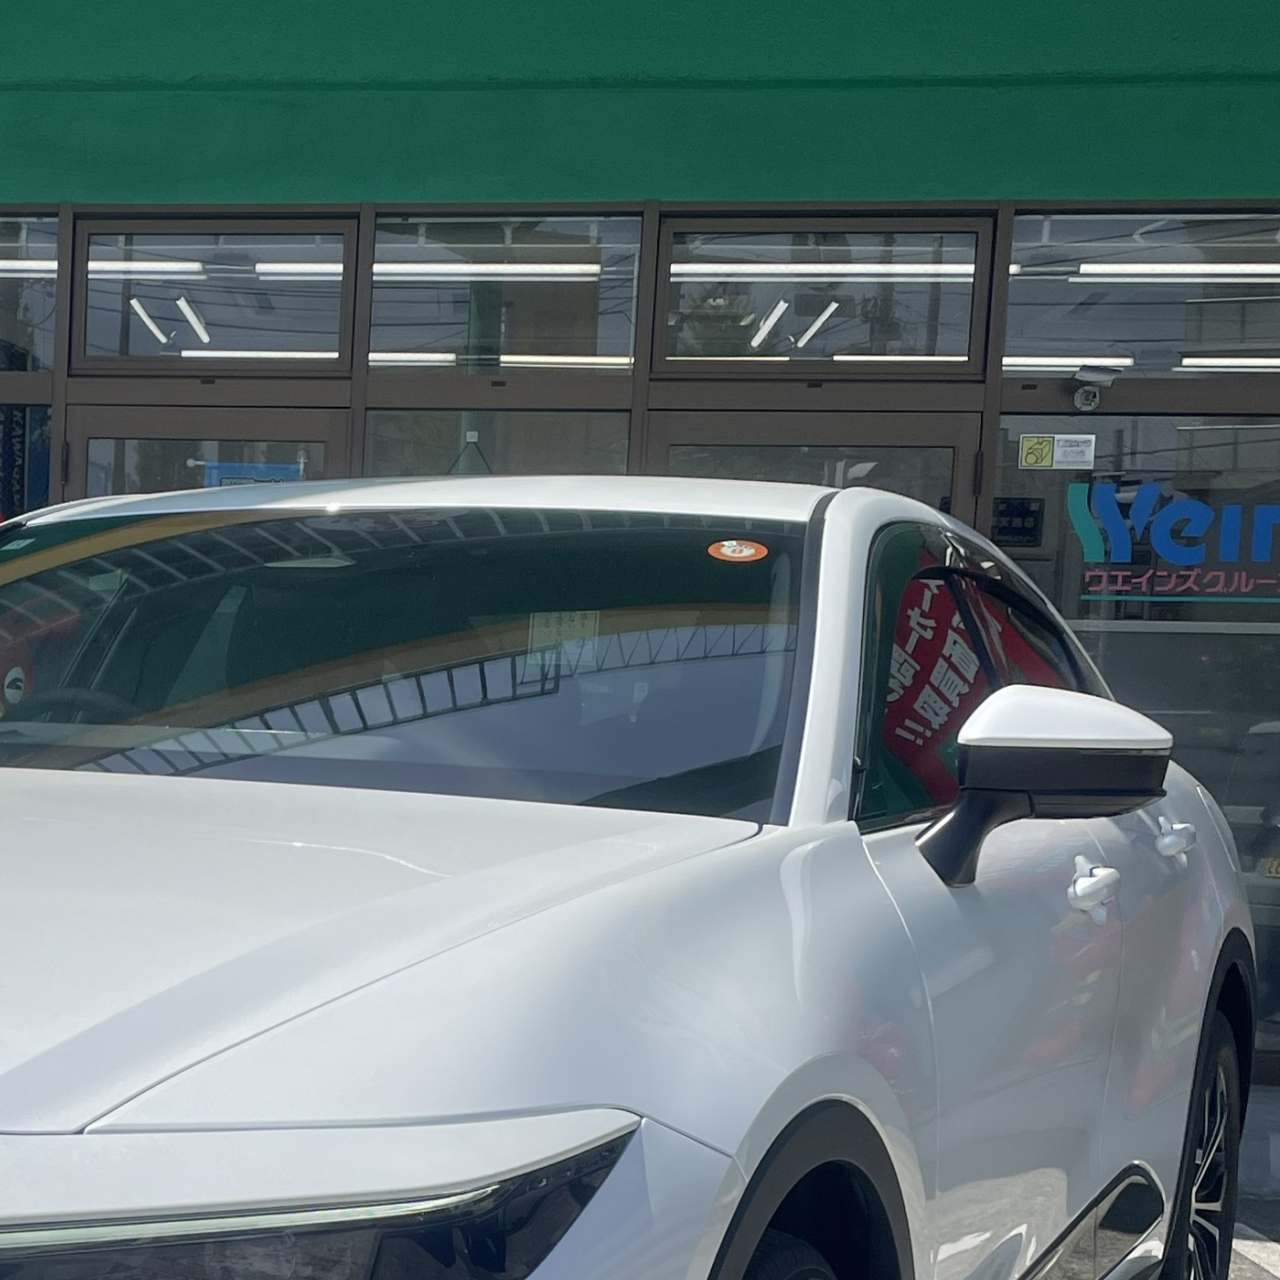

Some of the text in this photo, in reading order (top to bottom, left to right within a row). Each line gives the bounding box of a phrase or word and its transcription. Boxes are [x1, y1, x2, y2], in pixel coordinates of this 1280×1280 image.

[1084, 567, 1280, 593] ウエインズグルー
